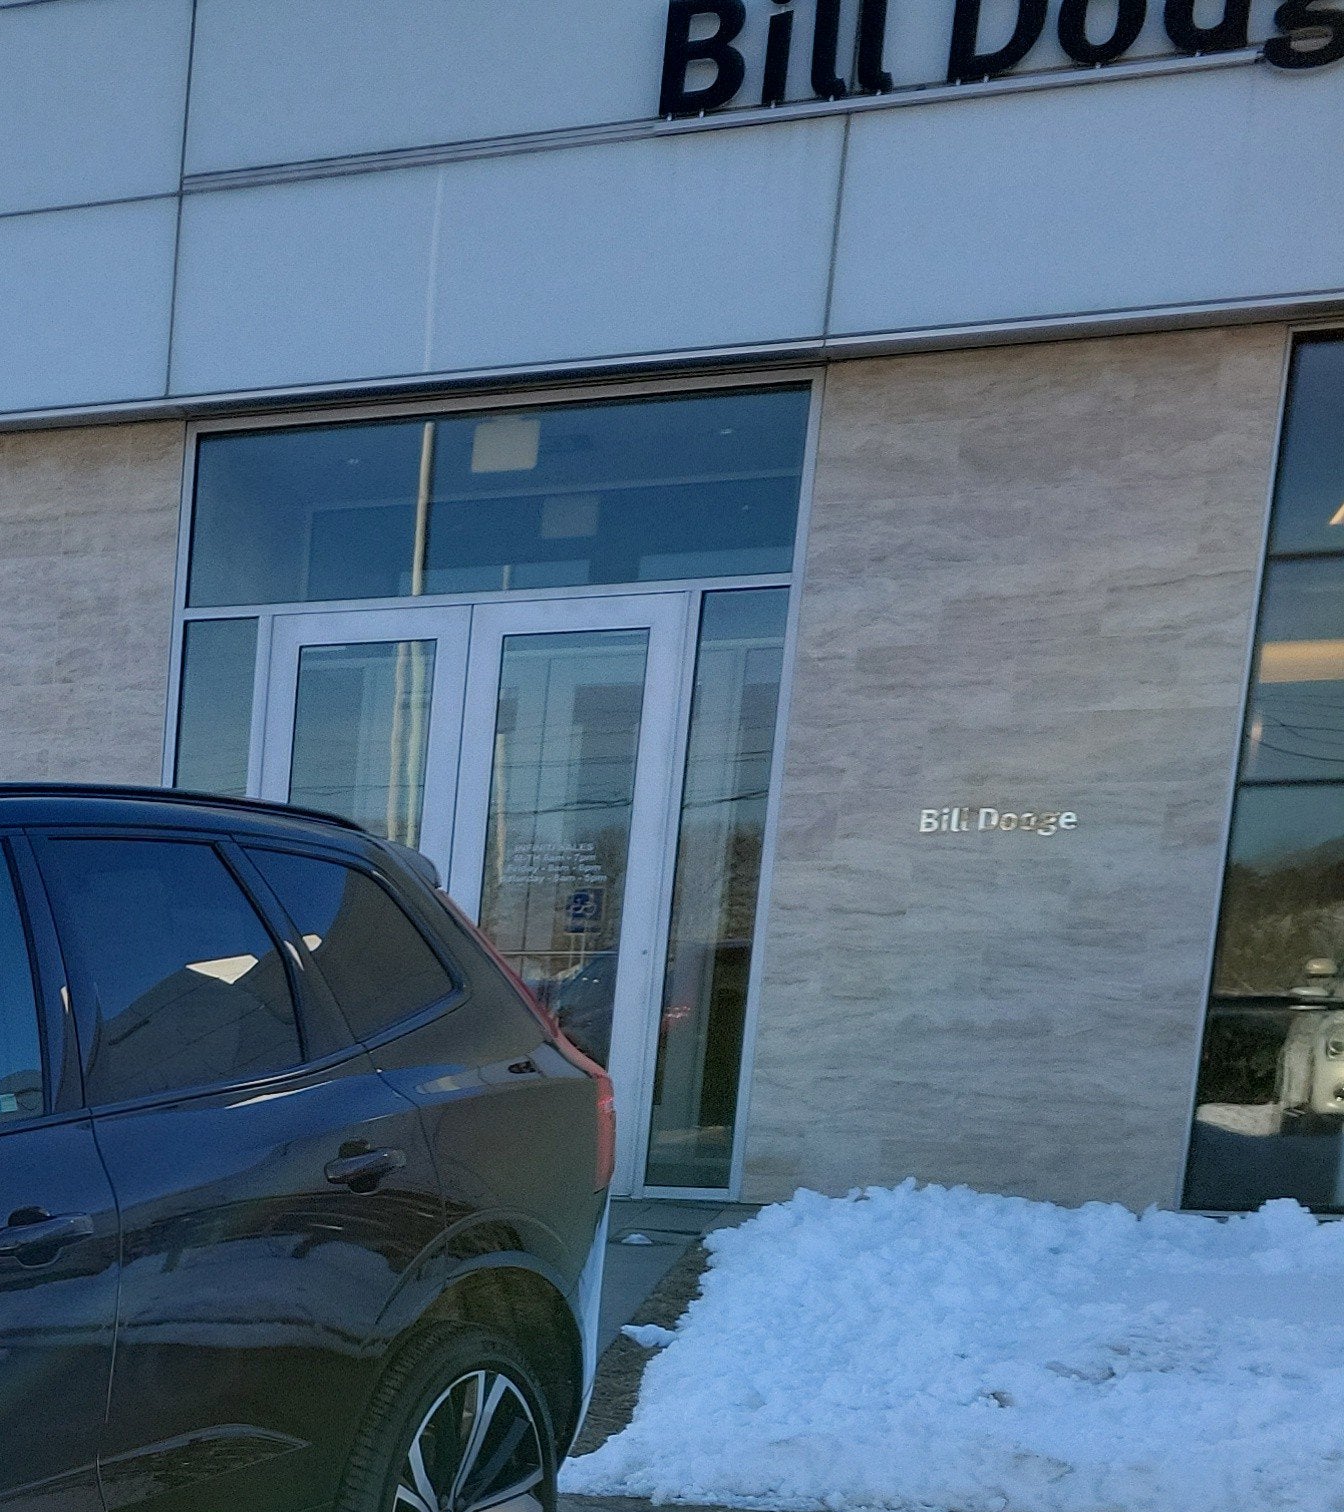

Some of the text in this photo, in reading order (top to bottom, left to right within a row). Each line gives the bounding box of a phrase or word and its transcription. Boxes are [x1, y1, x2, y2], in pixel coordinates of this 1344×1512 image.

[659, 0, 892, 117] Bill
[919, 807, 1078, 836] Bill Dodge
